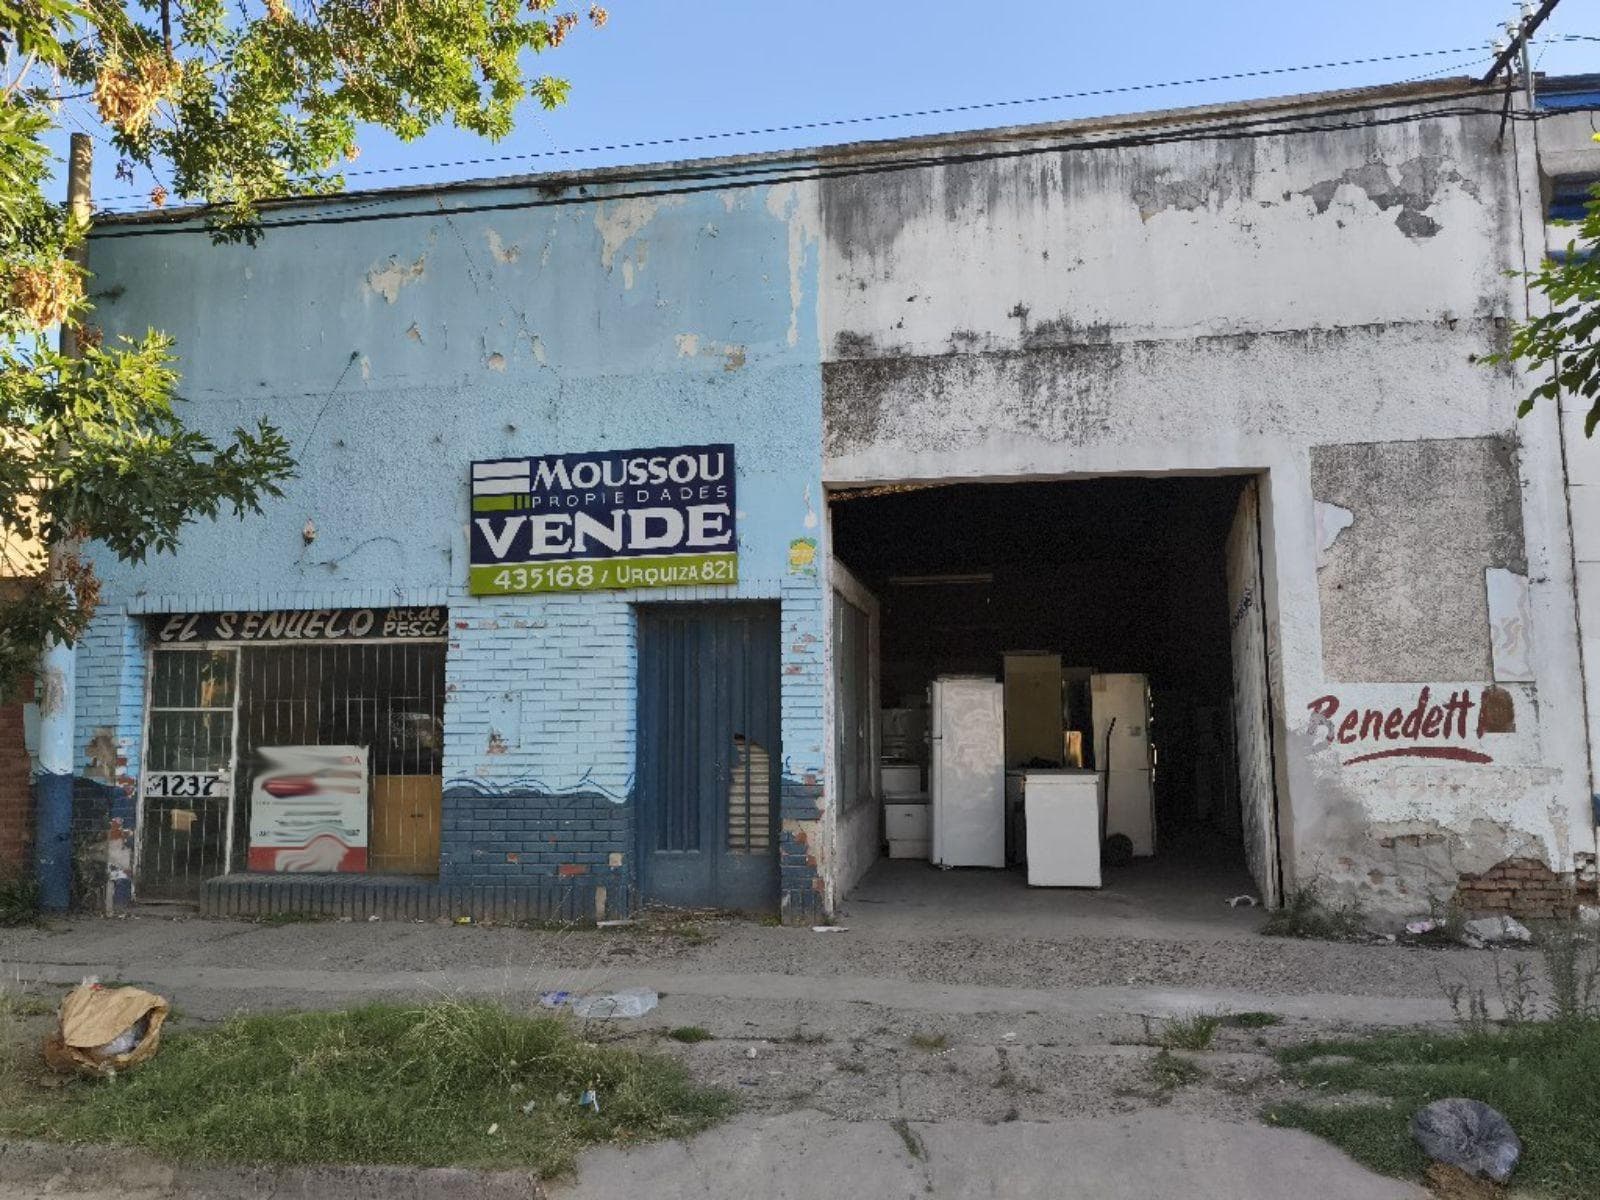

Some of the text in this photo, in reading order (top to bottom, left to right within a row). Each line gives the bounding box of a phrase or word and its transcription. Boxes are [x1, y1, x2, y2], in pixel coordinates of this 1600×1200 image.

[532, 453, 725, 490] MOUSSOU
[532, 485, 728, 509] PROPIEDADES
[474, 503, 732, 559] VENDE
[493, 565, 594, 590] 435168
[616, 565, 698, 585] URQUIZA
[701, 560, 734, 580] 821
[160, 614, 199, 641] EL
